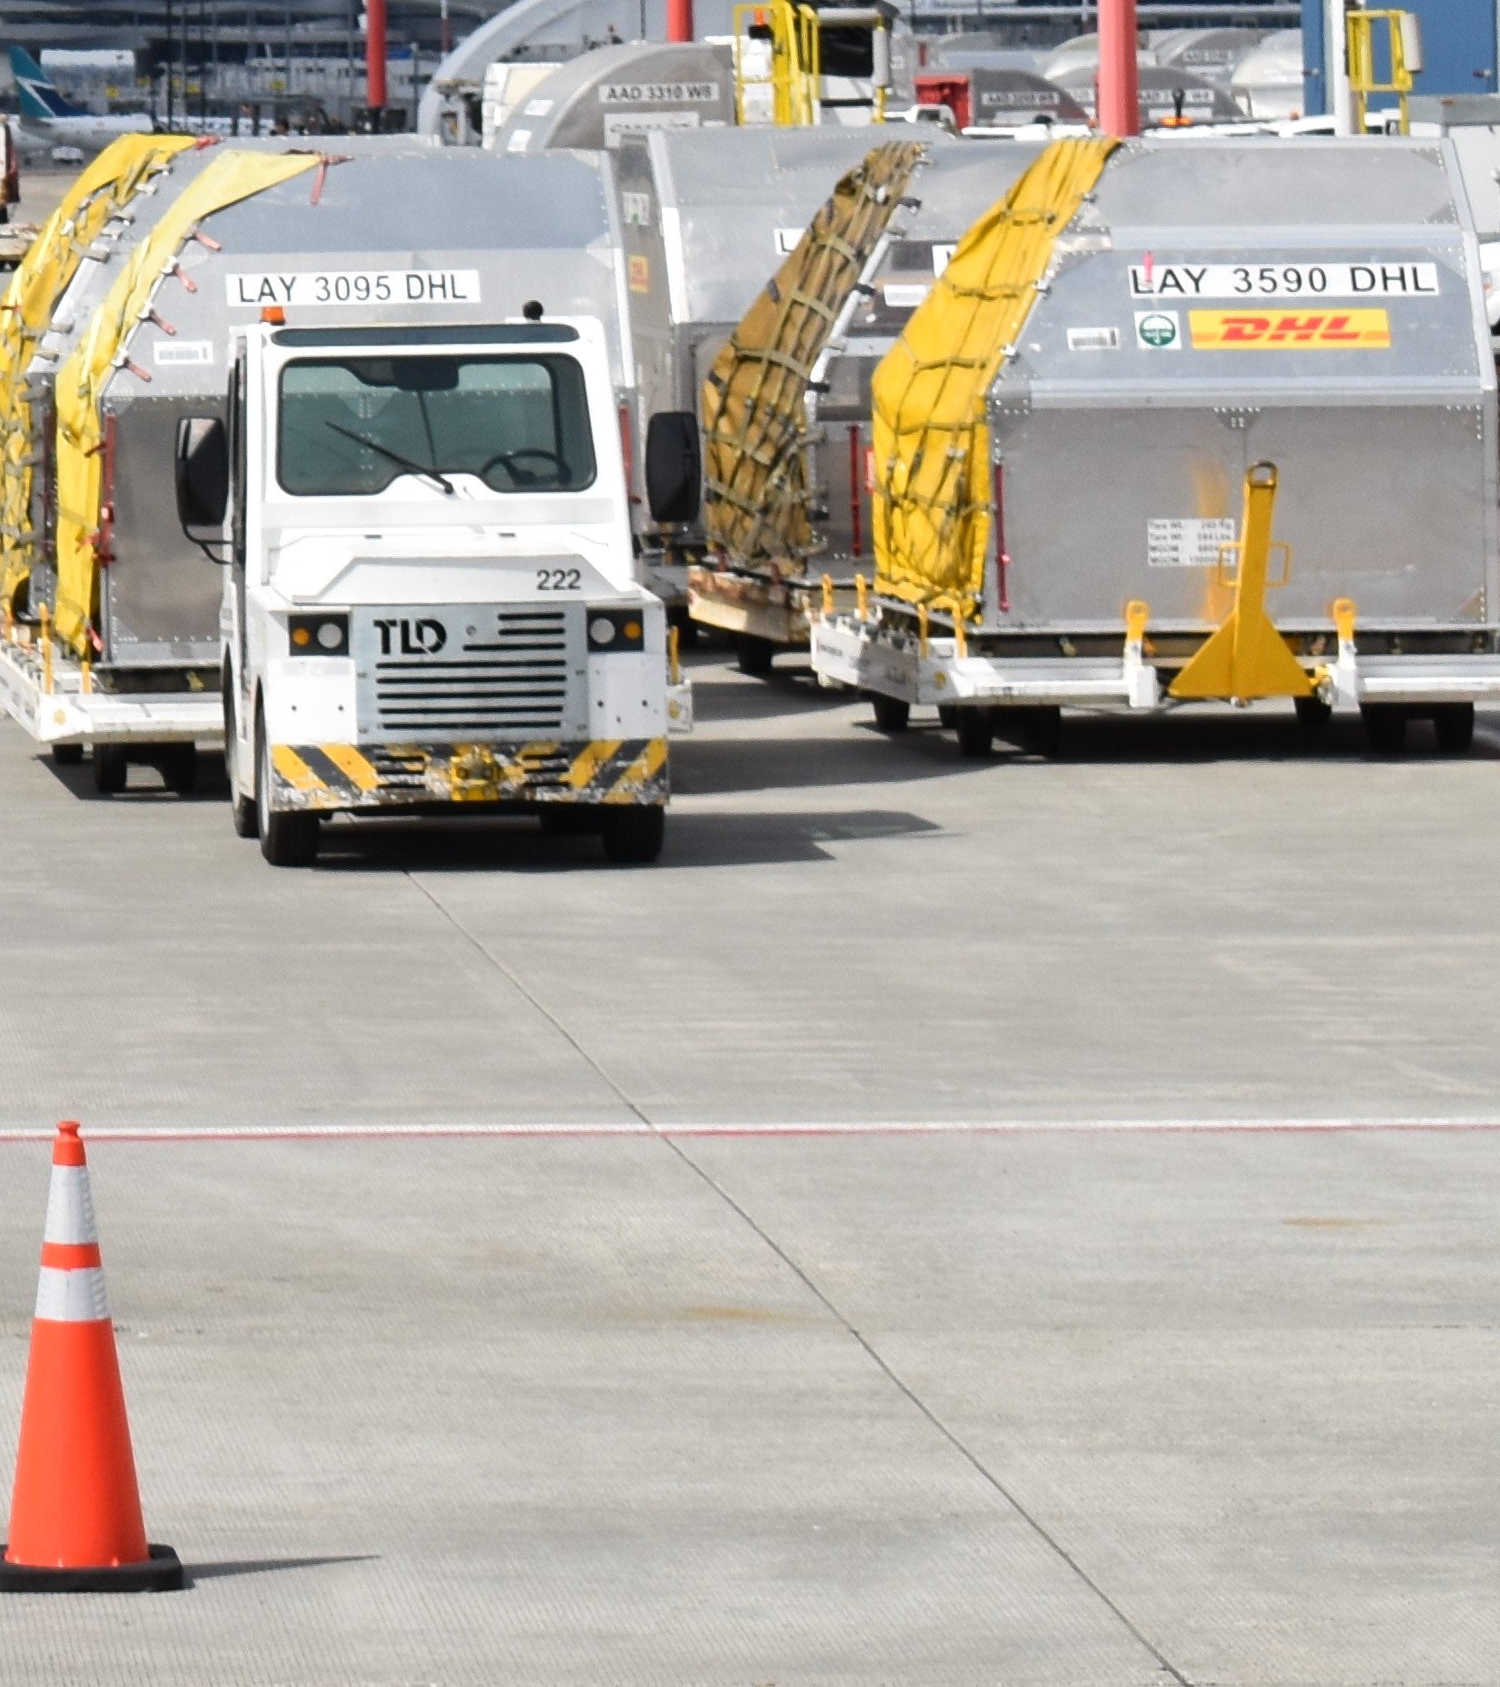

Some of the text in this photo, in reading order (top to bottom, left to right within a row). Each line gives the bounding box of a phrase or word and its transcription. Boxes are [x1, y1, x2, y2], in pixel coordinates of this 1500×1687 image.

[608, 86, 641, 100] AAD
[238, 273, 468, 303] LAY 3095 DHL
[1131, 266, 1436, 295] LAY 3590 DHL
[1220, 316, 1361, 341] DHL
[536, 568, 582, 590] 222
[373, 618, 448, 655] TLD
